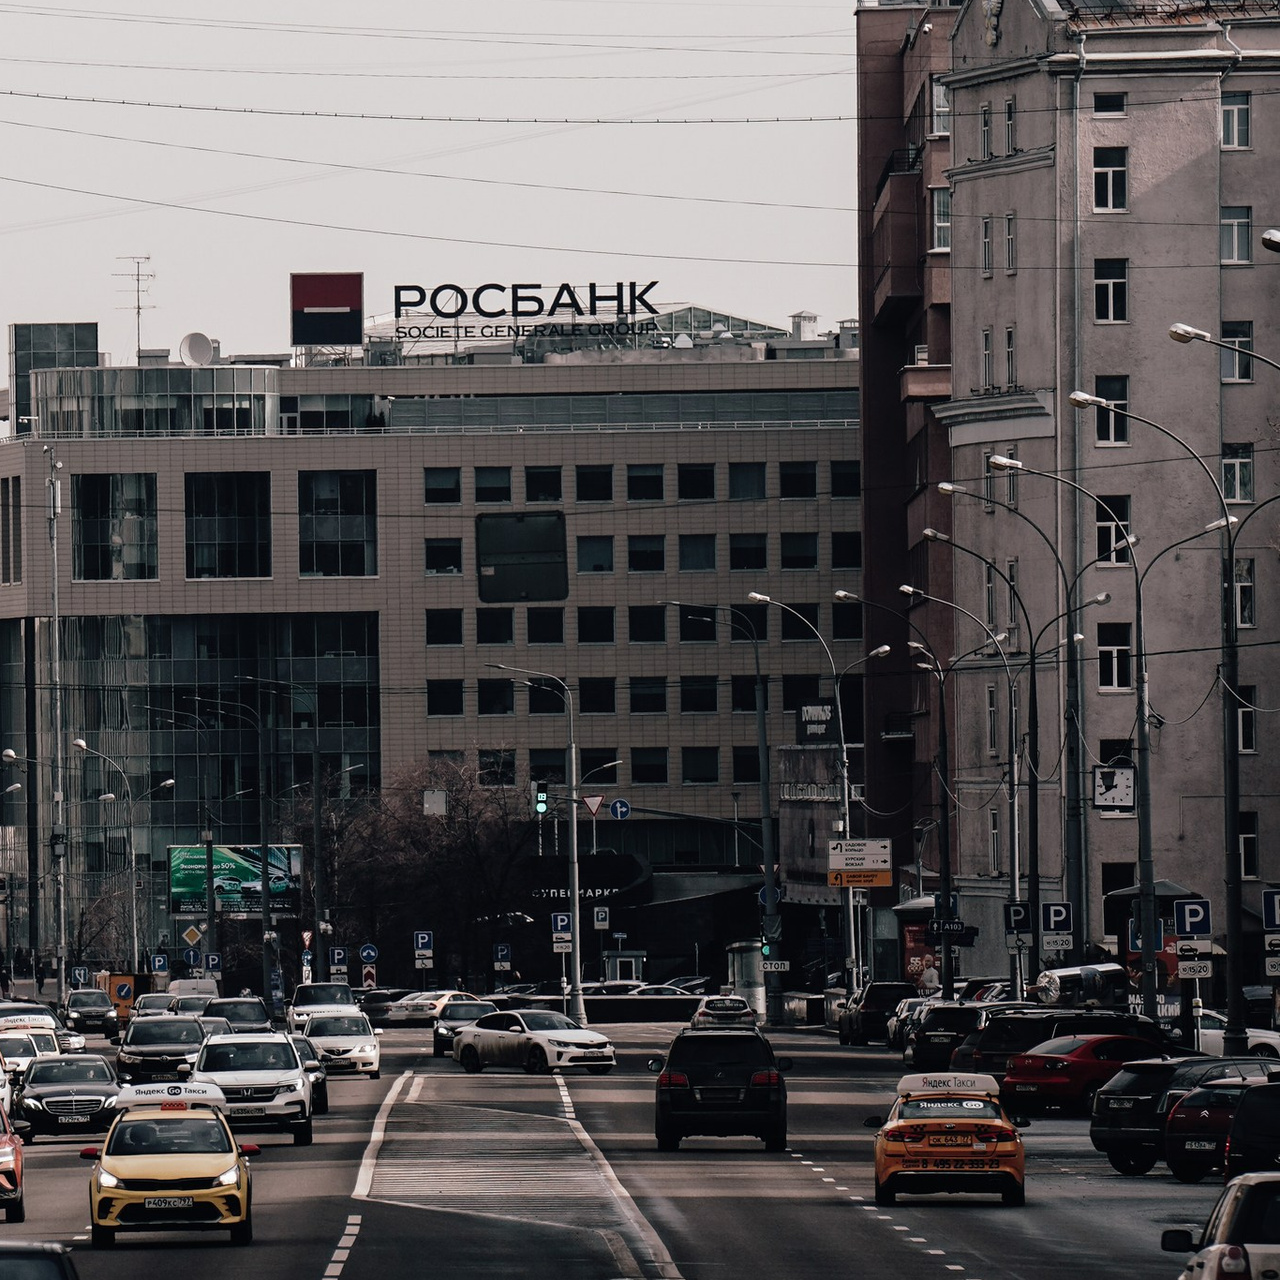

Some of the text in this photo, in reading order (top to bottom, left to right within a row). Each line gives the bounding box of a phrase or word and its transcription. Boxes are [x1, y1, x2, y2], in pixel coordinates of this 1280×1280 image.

[394, 280, 660, 318] РОСБАНК
[395, 322, 657, 339] SOCIETE GENERALE GROUP
[762, 962, 786, 970] СТОП
[1197, 965, 1208, 973] 20
[922, 1076, 976, 1088] Яндекс Такси
[135, 1087, 207, 1096] Яндекс Go Такси
[920, 1101, 960, 1109] Яндекс
[921, 1158, 928, 1169] 8
[933, 1158, 951, 1169] 495
